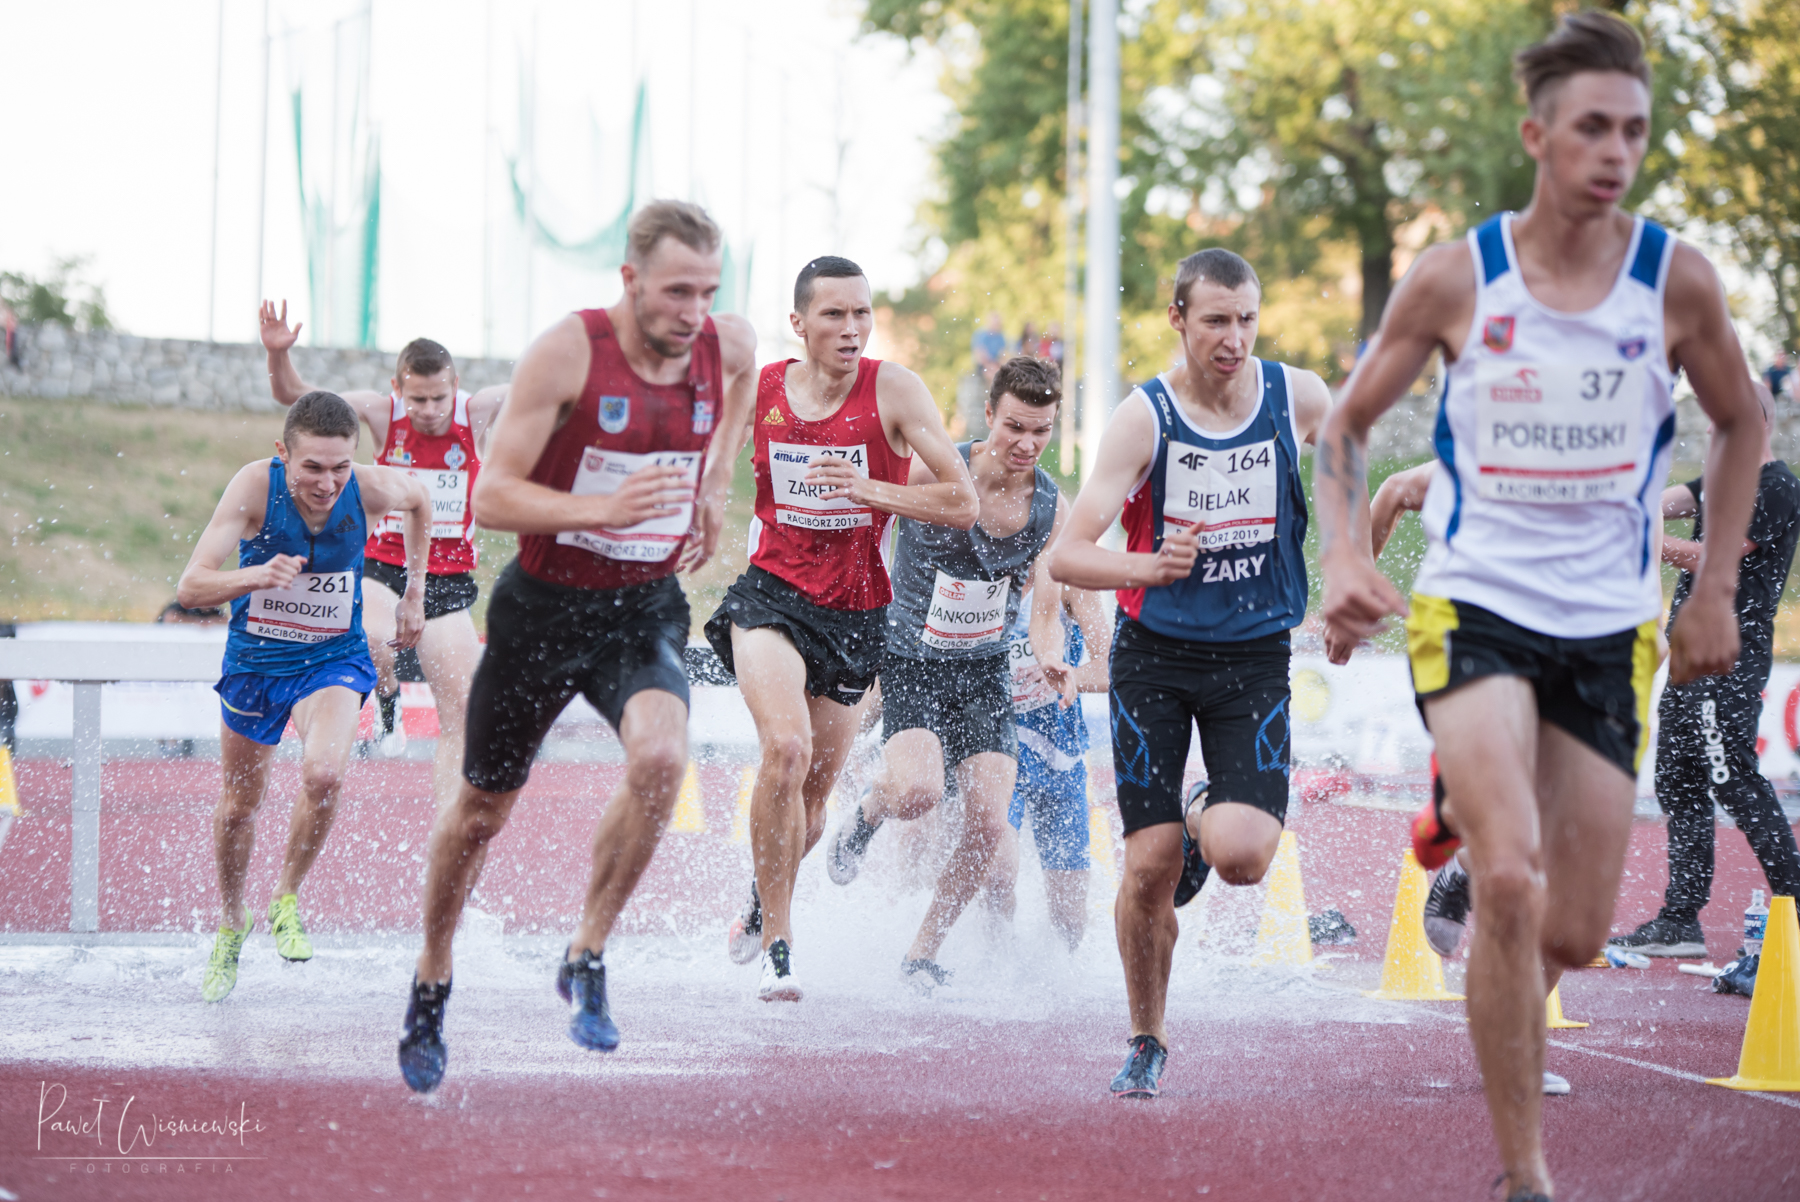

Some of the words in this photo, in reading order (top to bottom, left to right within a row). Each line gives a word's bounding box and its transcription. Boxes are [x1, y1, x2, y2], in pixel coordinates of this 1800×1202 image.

[1580, 369, 1625, 401] 37
[1492, 422, 1626, 456] PORĘBSKI
[1178, 452, 1208, 471] 4F
[1227, 447, 1271, 474] 164
[436, 474, 458, 489] 53
[1188, 487, 1251, 511] BIELAK
[787, 514, 831, 527] RACIBÓRZ
[834, 517, 859, 527] 2019
[573, 534, 636, 557] RACIBÓRZ
[1232, 529, 1260, 541] 2019
[1202, 553, 1266, 583] ŻARY
[307, 576, 349, 593] 261
[986, 580, 1005, 600] 97
[263, 598, 339, 618] BRODZIK
[931, 603, 1004, 624] JANKOWSKI
[258, 626, 309, 641] RACIBÓRZ
[1702, 699, 1730, 784] adidas
